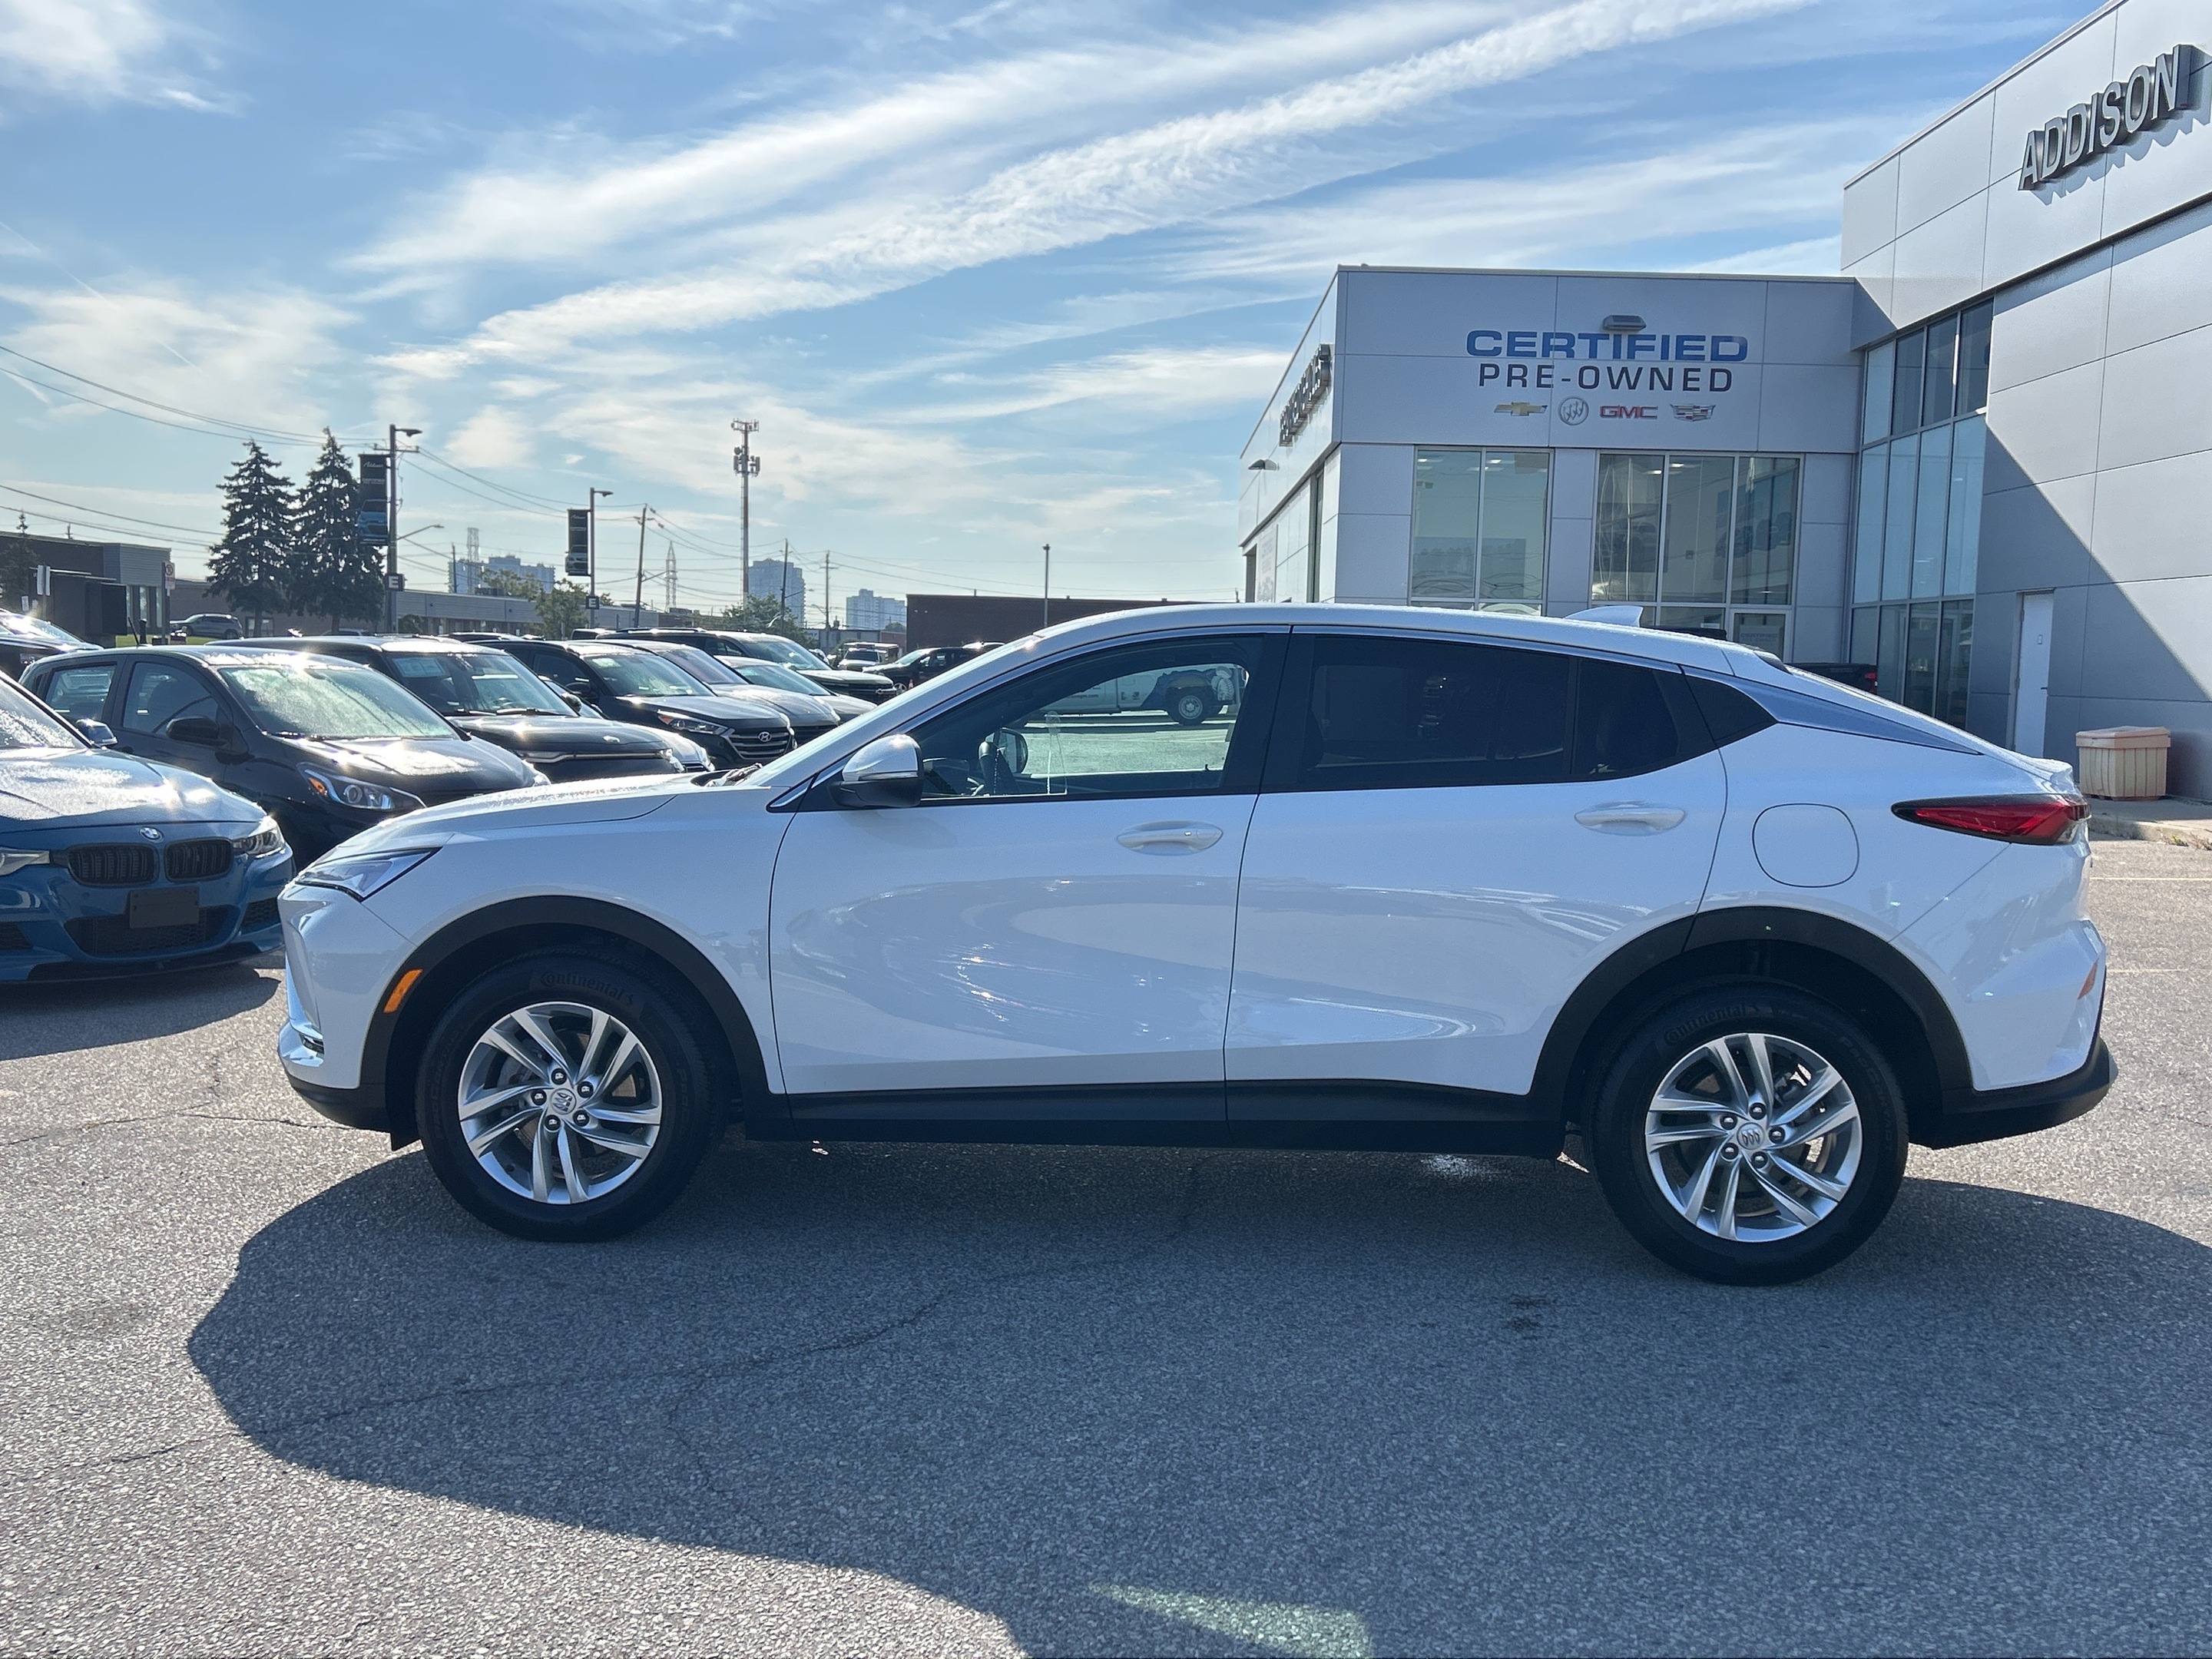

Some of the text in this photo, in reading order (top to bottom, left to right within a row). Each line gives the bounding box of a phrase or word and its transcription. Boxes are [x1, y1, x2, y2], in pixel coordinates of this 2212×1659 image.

[2018, 44, 2191, 190] ADDISON
[1466, 329, 1749, 362] CERTIFIED
[1479, 363, 1734, 392] PRE-OWNED
[1599, 405, 1659, 419] GMC
[389, 576, 399, 588] E
[589, 598, 597, 608] E
[540, 972, 625, 1000] Continental
[1665, 1004, 1747, 1045] Continental
